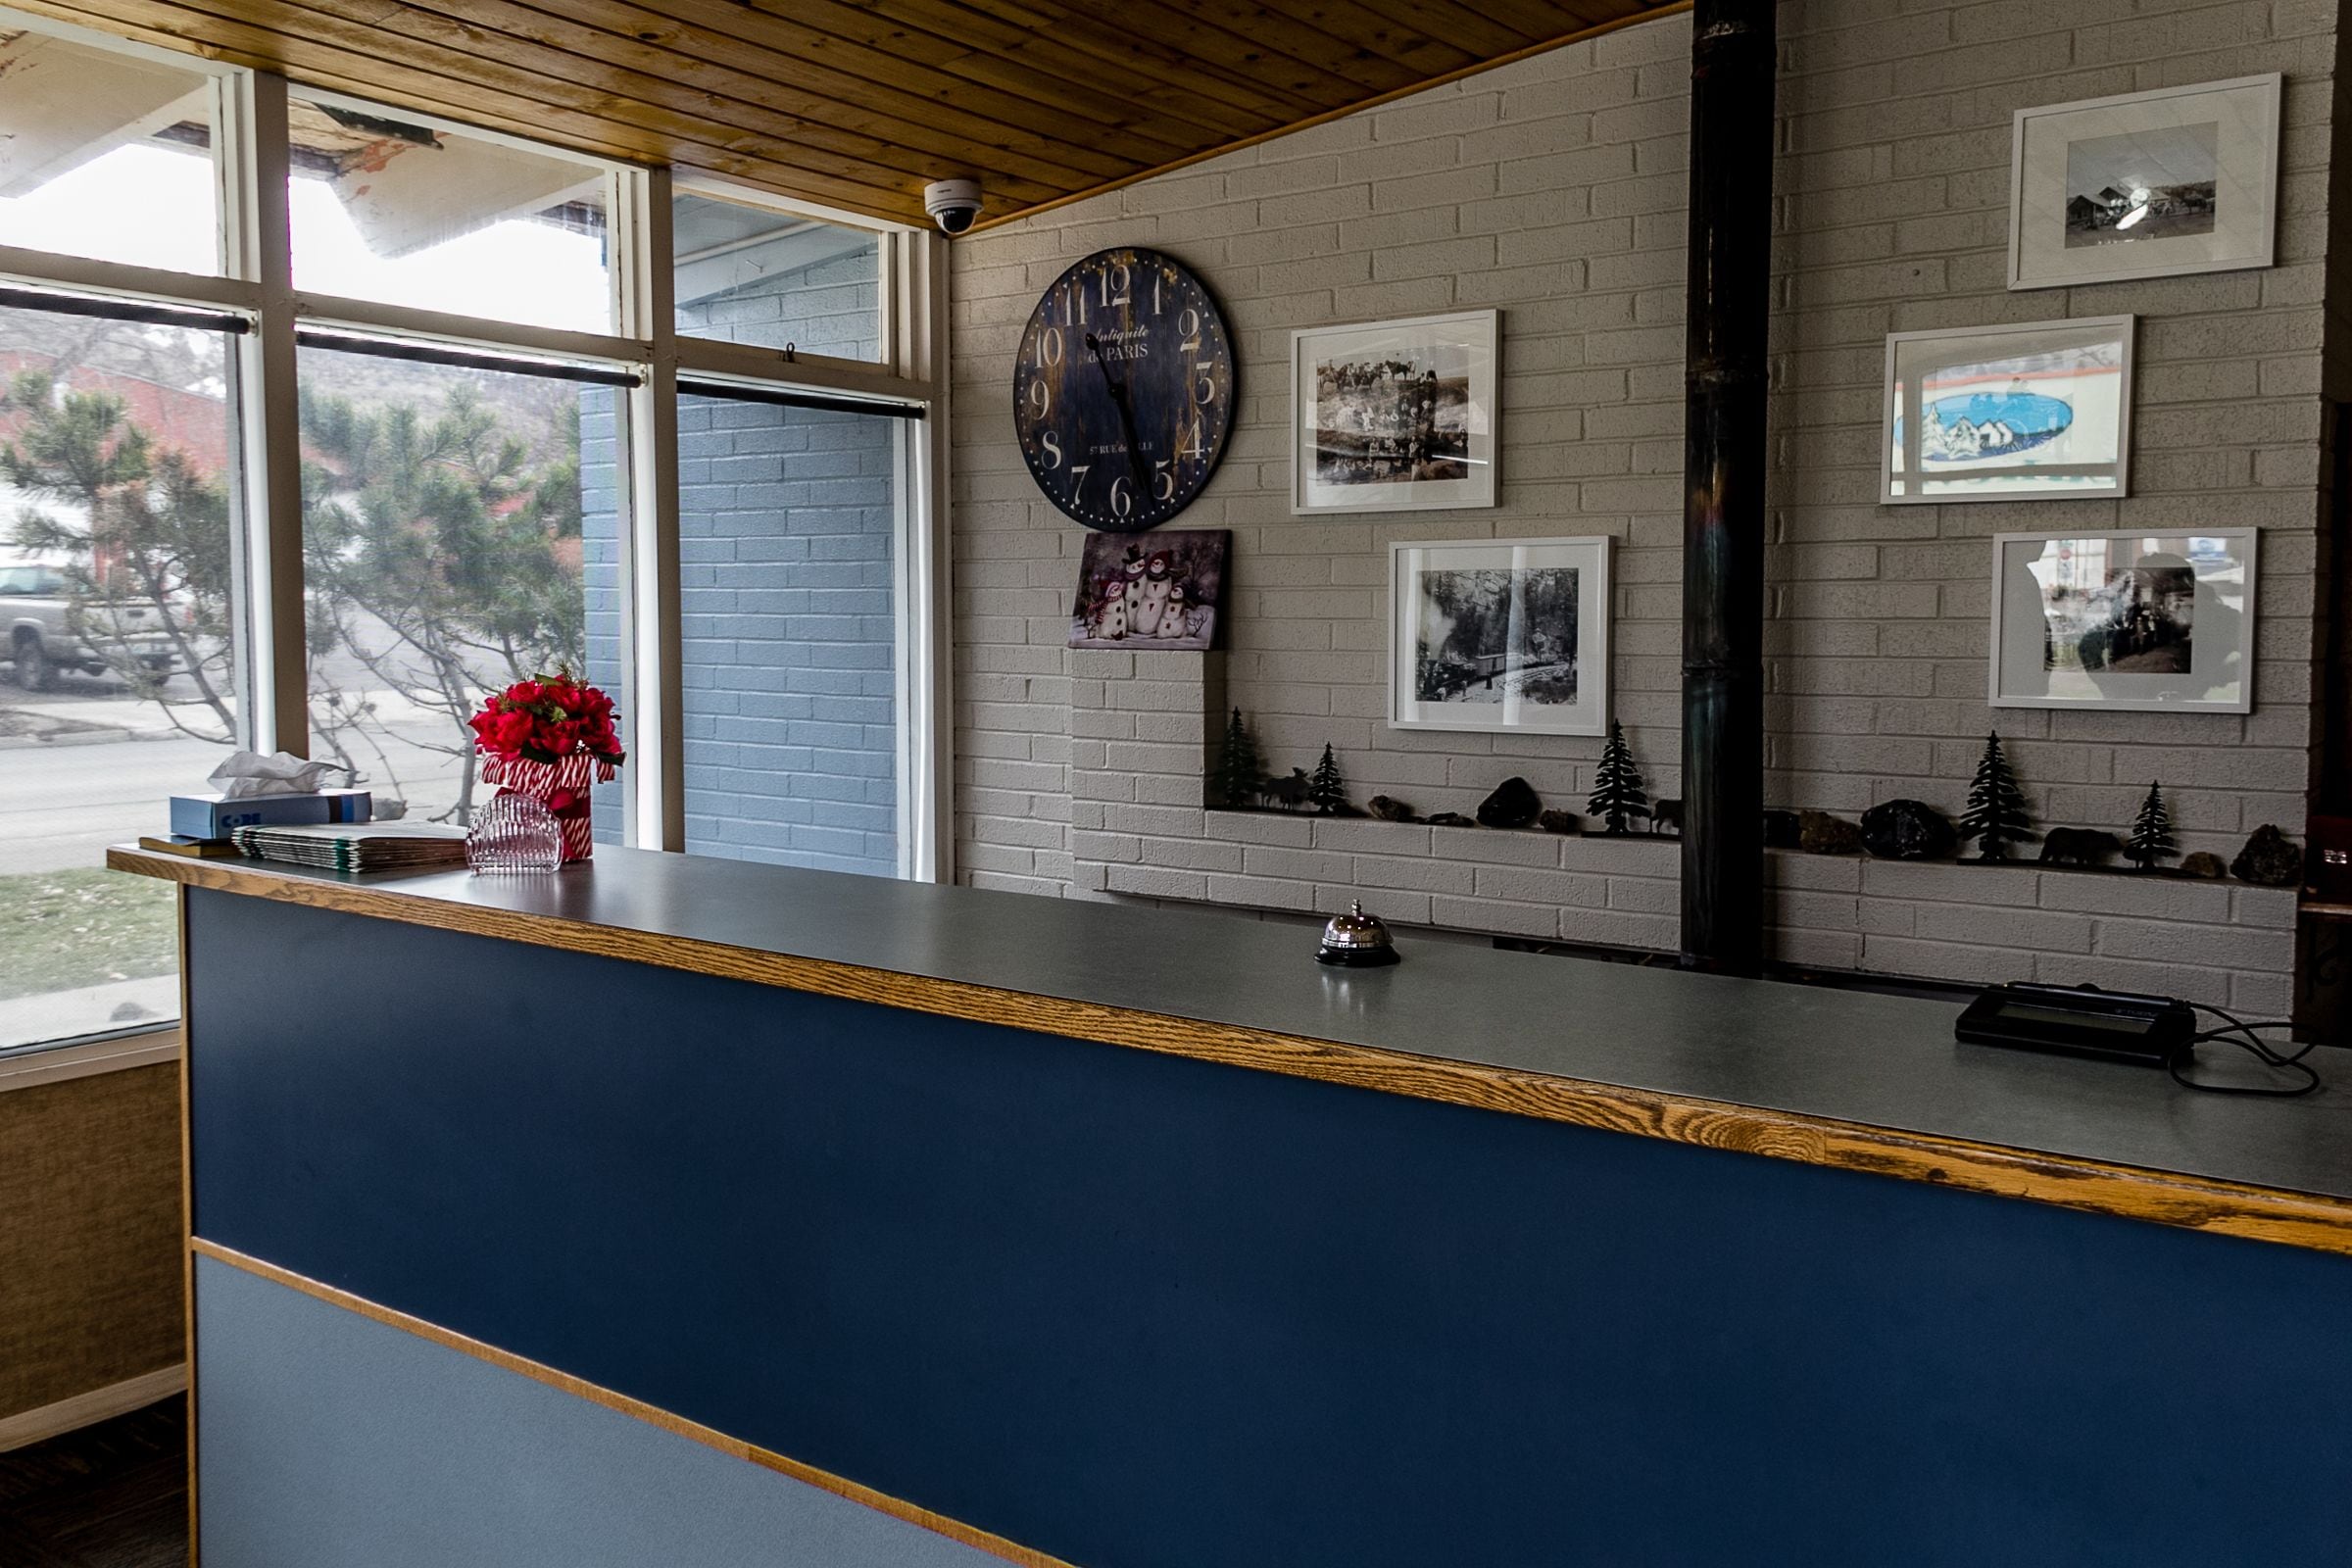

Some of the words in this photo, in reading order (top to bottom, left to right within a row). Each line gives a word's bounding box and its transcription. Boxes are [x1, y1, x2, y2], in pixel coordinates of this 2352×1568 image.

[1100, 264, 1131, 308] 12
[1152, 274, 1163, 316] 1
[1064, 287, 1087, 327] 11
[1034, 327, 1062, 369] 10
[1178, 309, 1200, 353] 2
[1106, 343, 1149, 362] PARIS
[1031, 380, 1051, 421] 9
[1195, 362, 1216, 405] 3
[1041, 431, 1062, 470] 8
[1182, 419, 1205, 460] 4
[1071, 466, 1091, 505] 7
[1110, 476, 1132, 517] 6
[1154, 460, 1174, 501] 5
